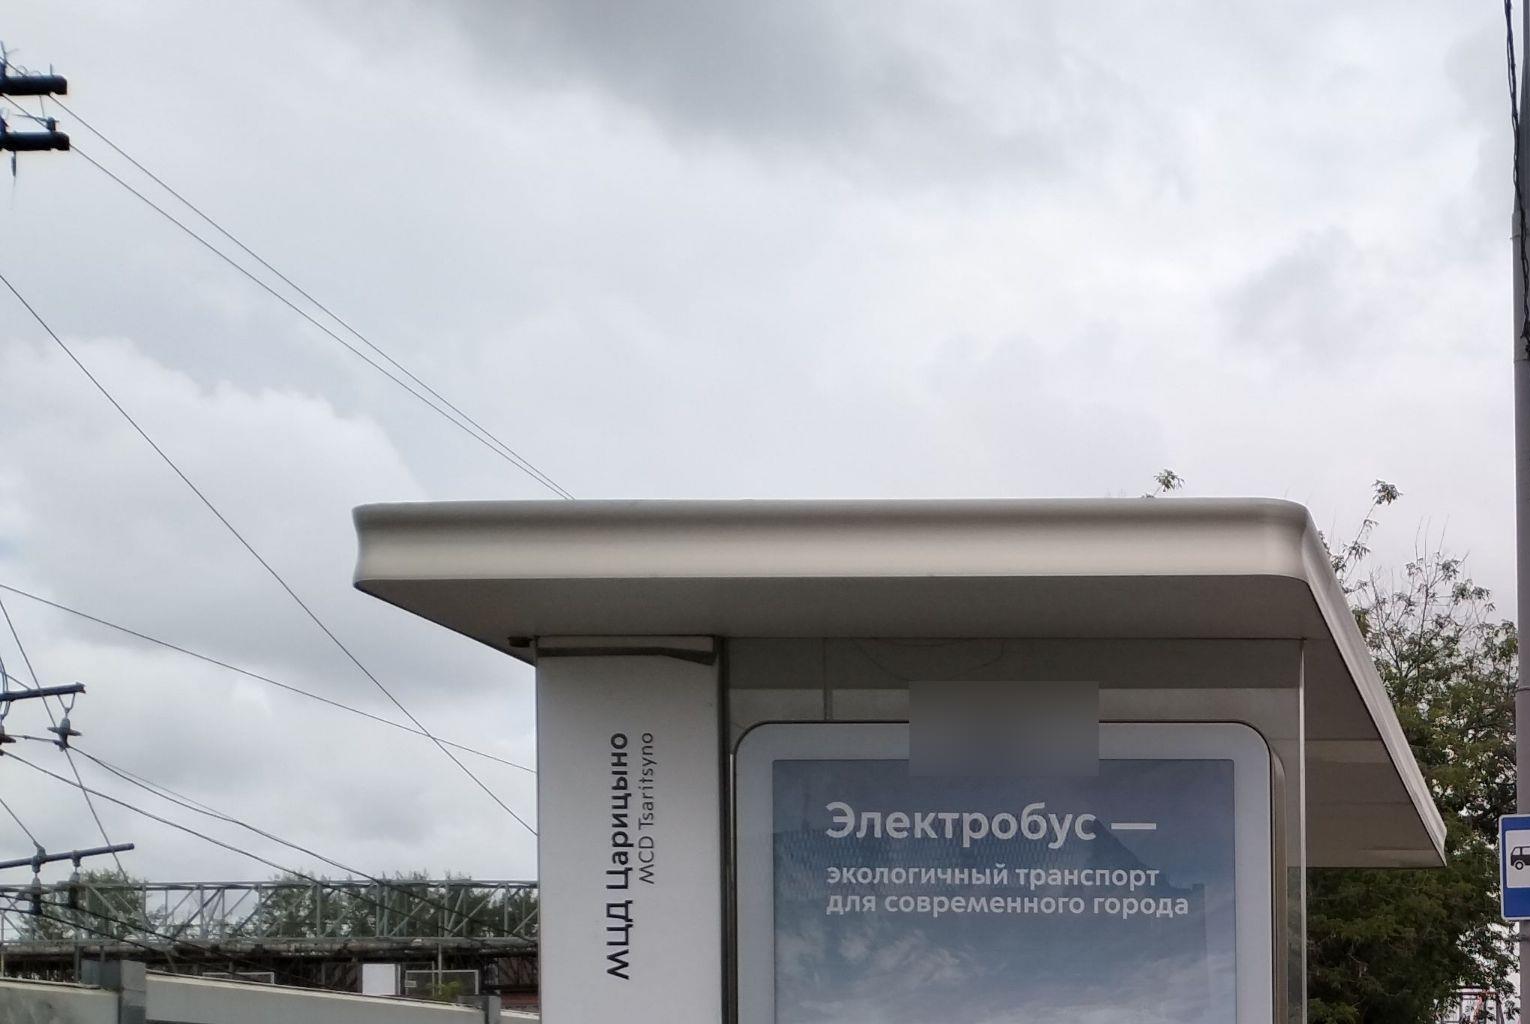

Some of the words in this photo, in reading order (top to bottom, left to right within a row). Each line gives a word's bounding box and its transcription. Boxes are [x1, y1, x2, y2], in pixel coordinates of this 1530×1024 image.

[638, 732, 658, 831] Tsaritsyno
[606, 732, 634, 890] Царицыно
[825, 801, 1096, 849] Электробус
[638, 836, 655, 884] MCD
[826, 863, 1007, 887] экологичный
[1016, 866, 1159, 892] транспорт
[826, 894, 876, 916] для
[884, 896, 1085, 918] современного
[1093, 897, 1188, 919] города
[606, 900, 633, 980] МЦД
